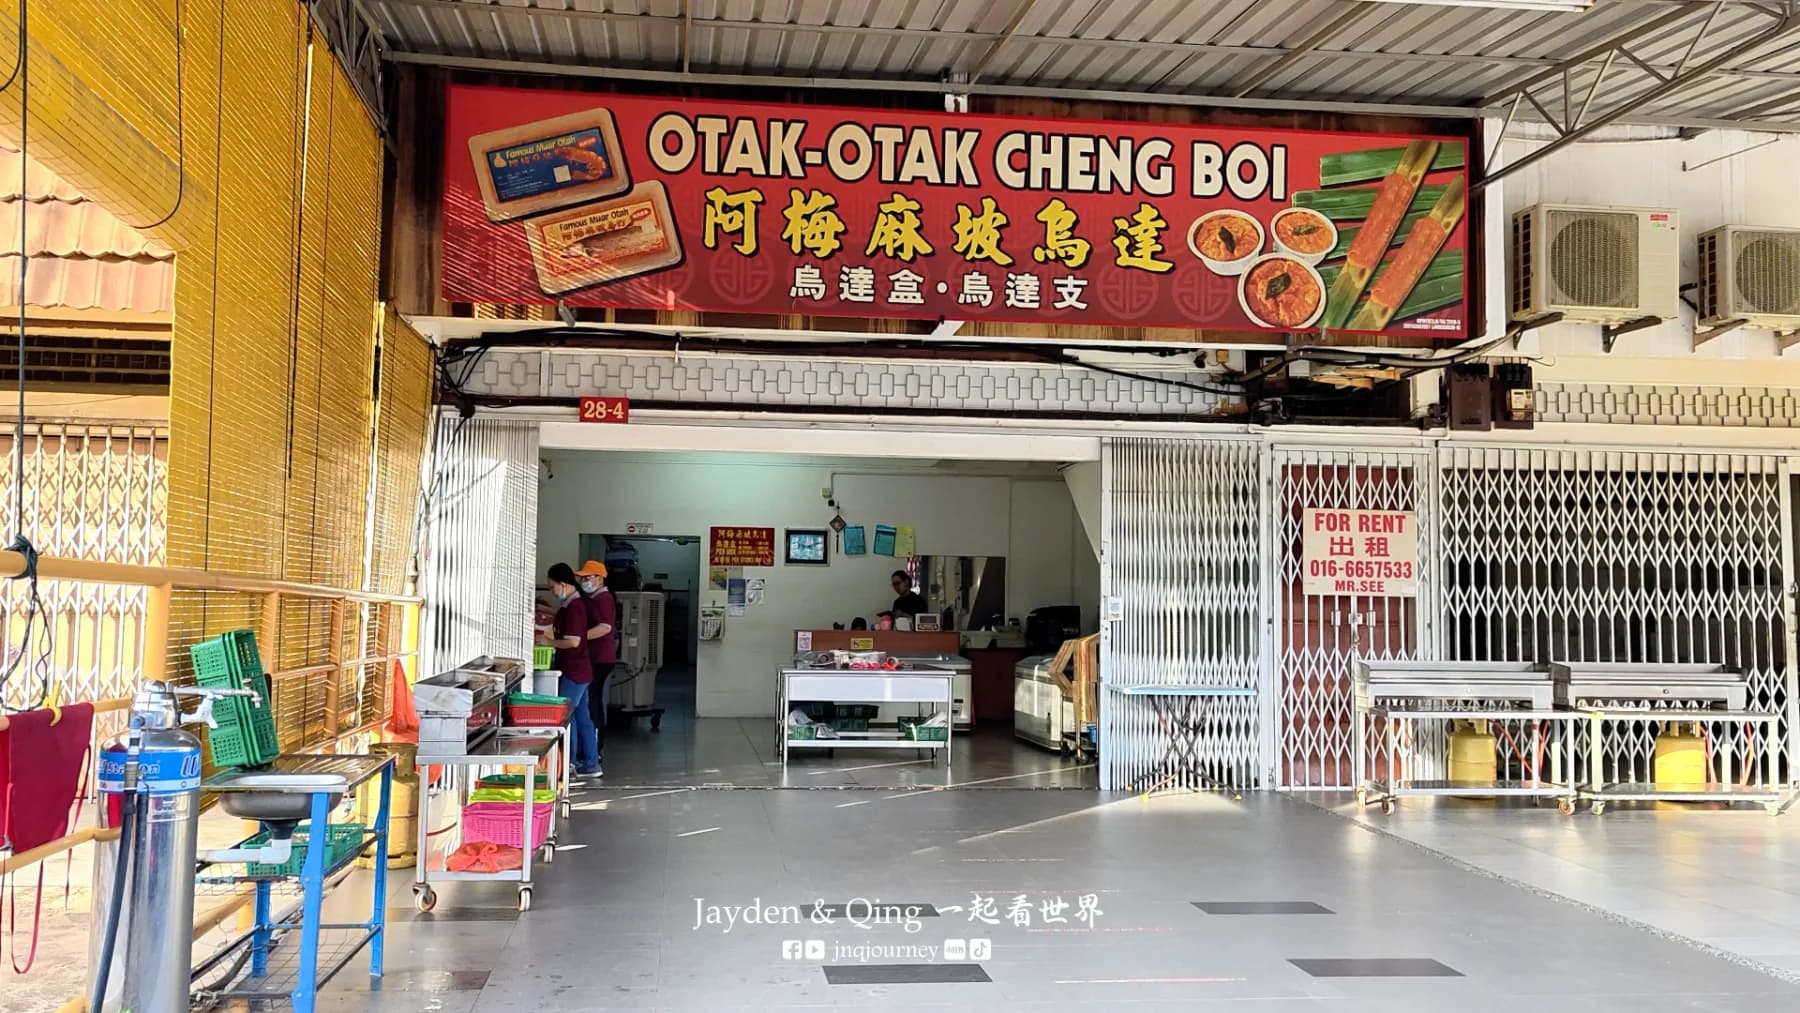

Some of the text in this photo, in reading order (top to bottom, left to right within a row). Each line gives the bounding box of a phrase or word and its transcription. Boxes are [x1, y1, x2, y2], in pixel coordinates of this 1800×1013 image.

[649, 113, 1287, 200] OTAK-OTAK CHENG BOI
[559, 219, 588, 232] Famous
[589, 214, 609, 225] Muar
[703, 186, 1174, 272] 阿梅麻坡烏達
[583, 400, 625, 419] 28-4
[1314, 512, 1407, 534] FOR RENT
[1329, 536, 1390, 558] 出租
[1310, 559, 1412, 579] 016-6657533
[1335, 580, 1385, 593] MR.SEE
